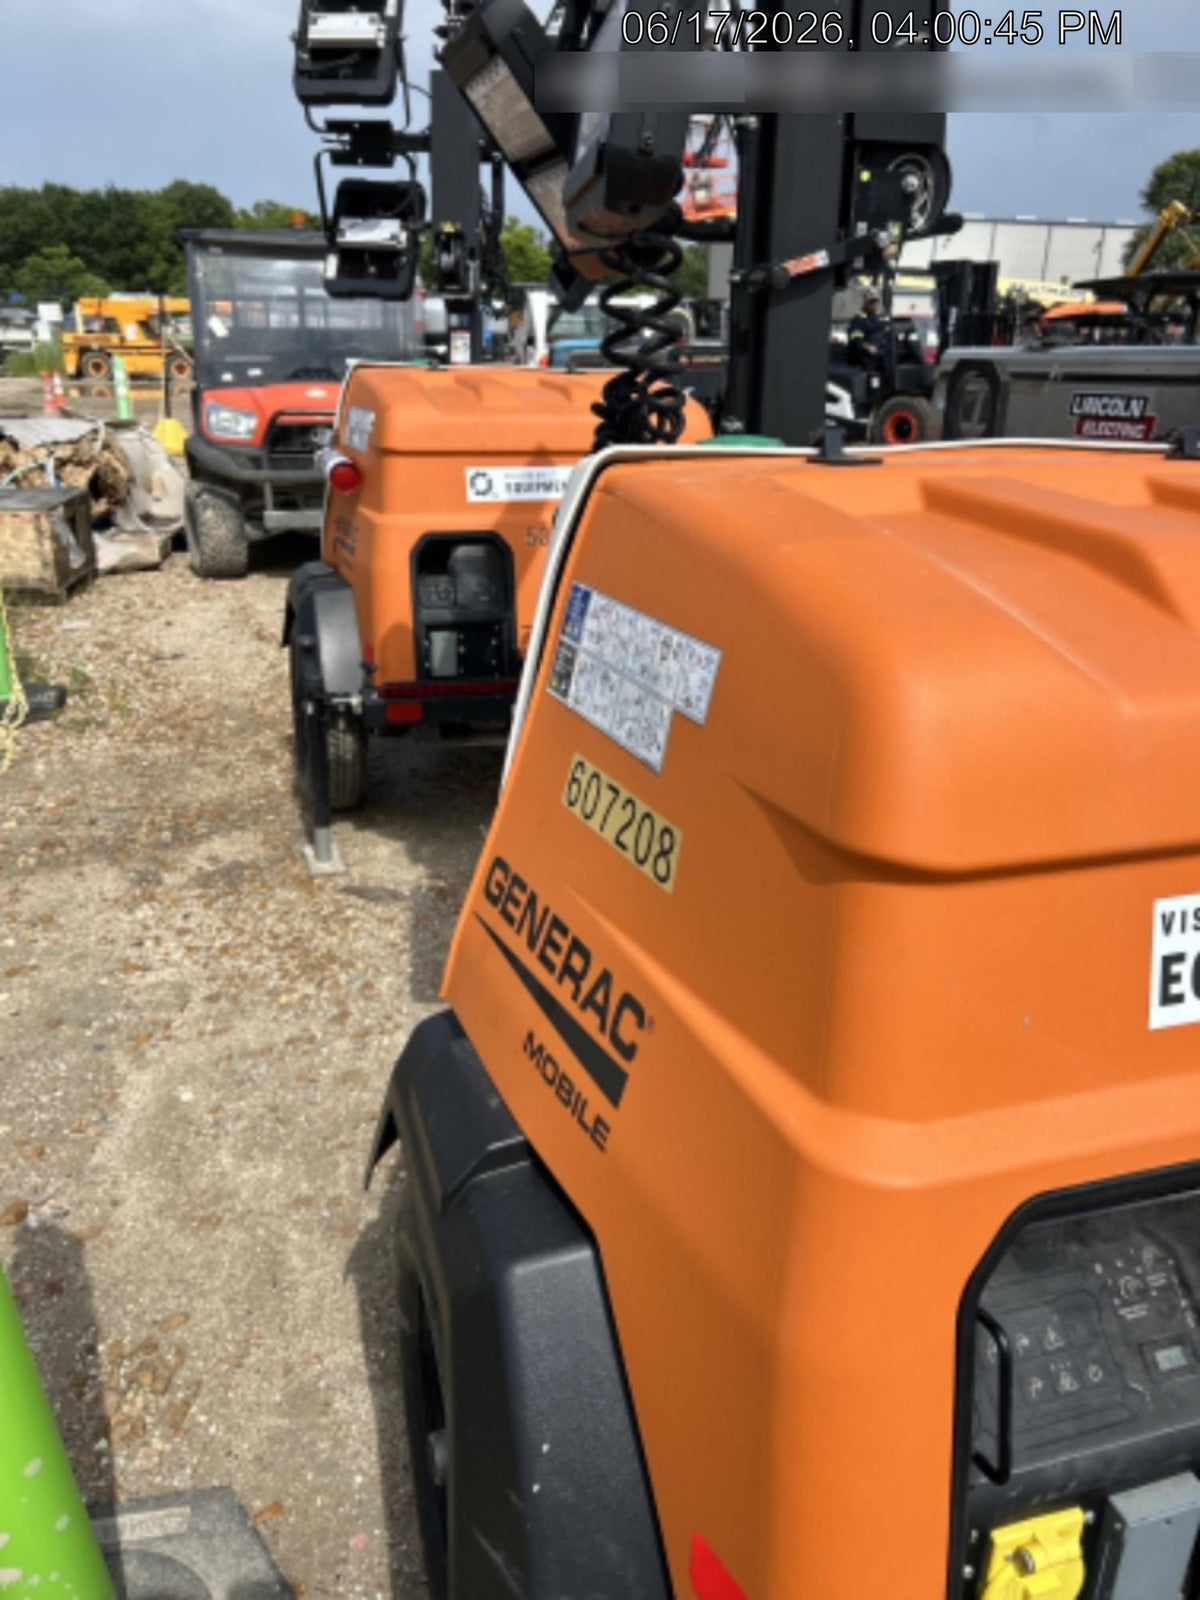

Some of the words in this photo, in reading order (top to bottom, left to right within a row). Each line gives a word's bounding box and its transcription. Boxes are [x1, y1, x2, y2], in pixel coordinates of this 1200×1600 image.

[1073, 395, 1146, 418] LINCOLN
[566, 760, 676, 884] 607208
[483, 855, 646, 1063] GENERAC
[522, 1029, 611, 1152] MOBILE
